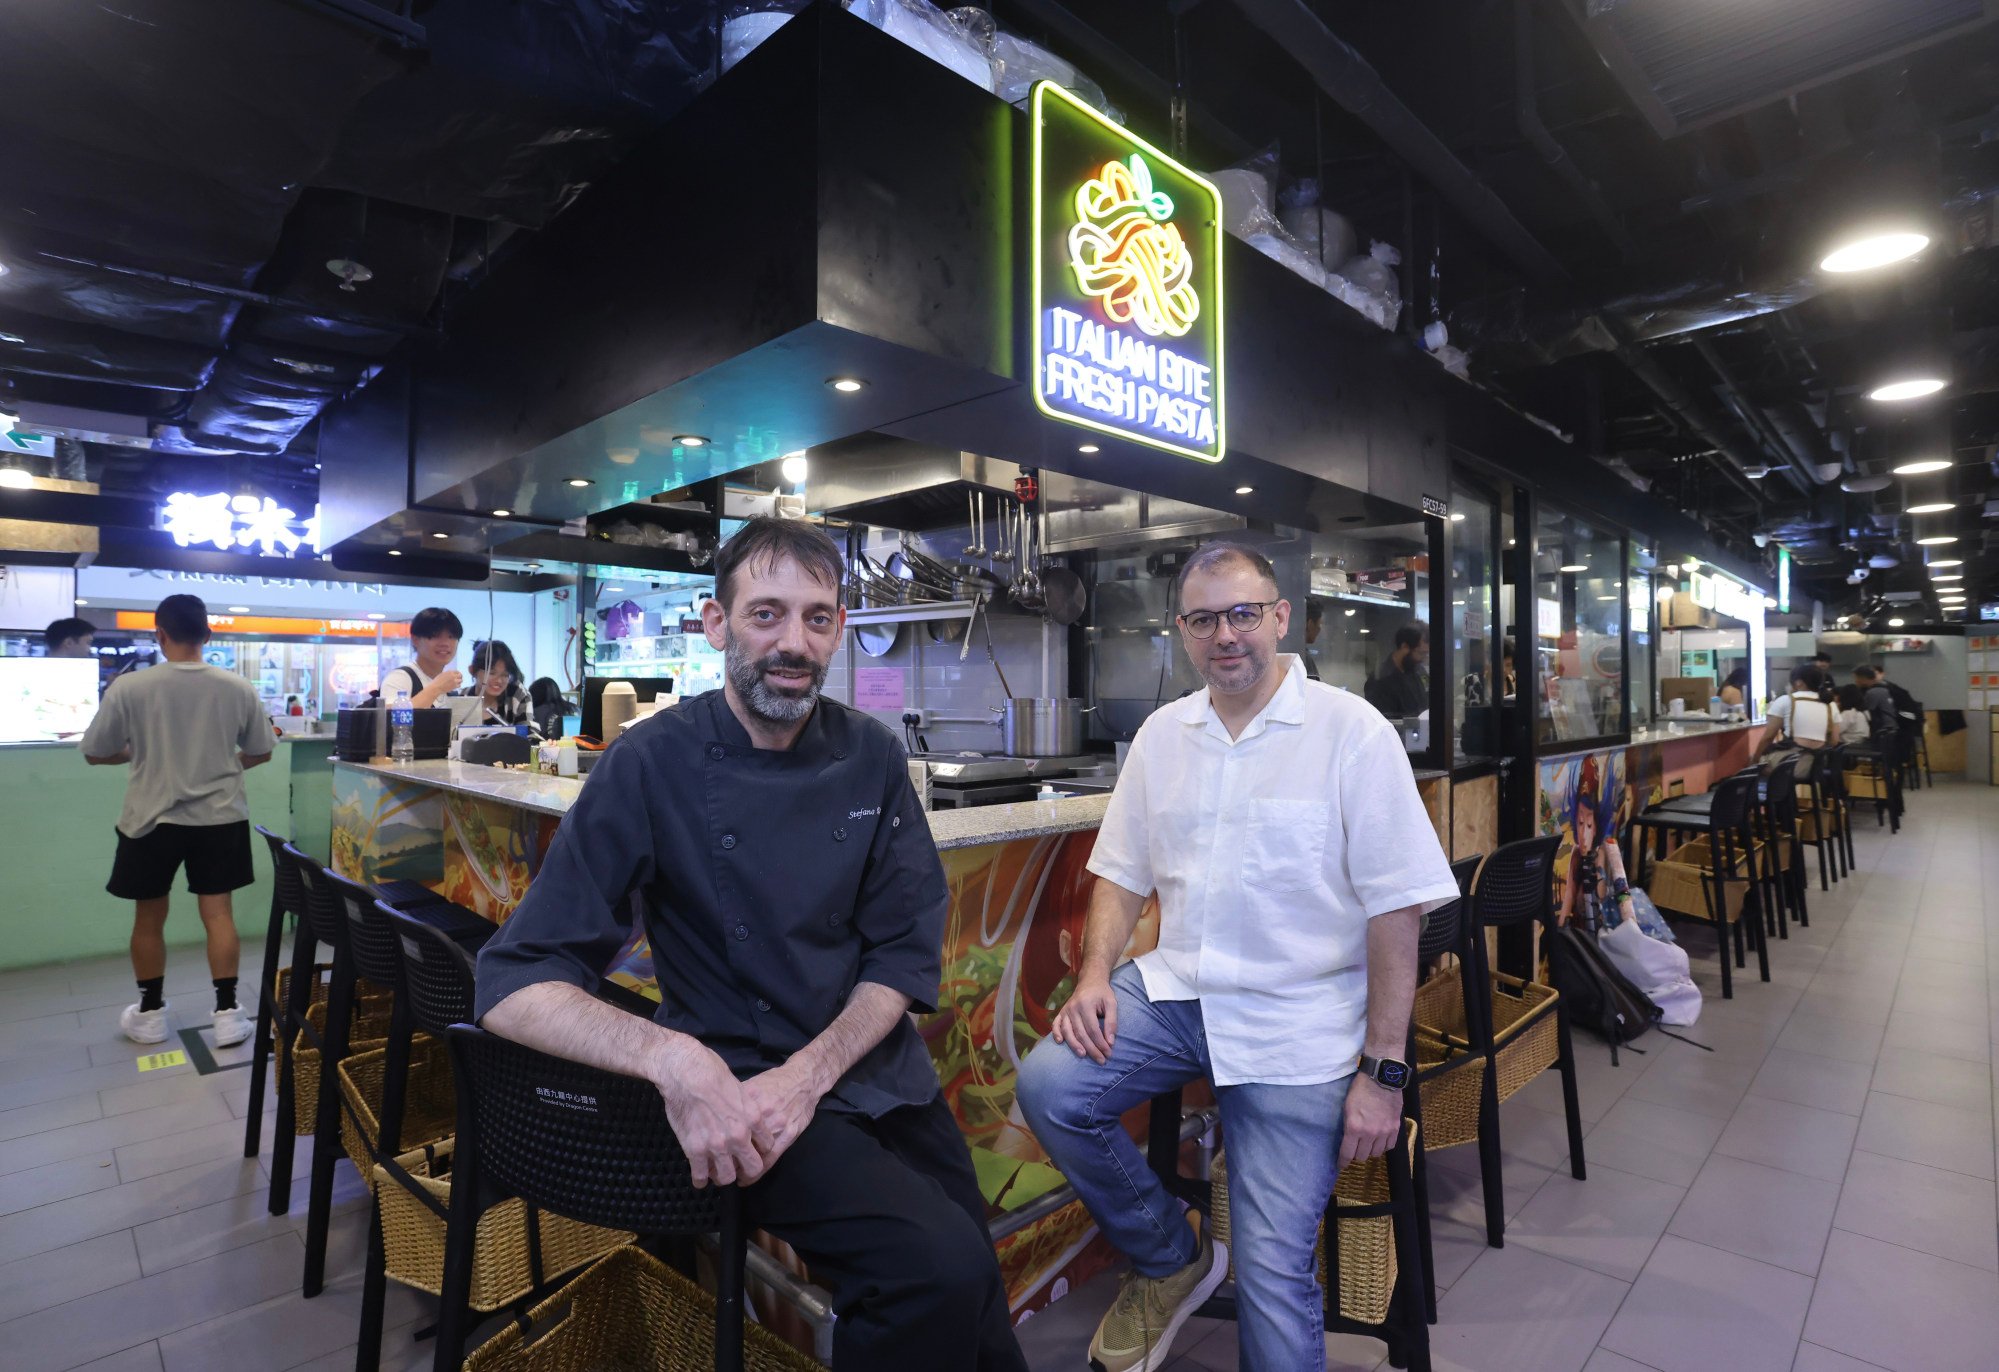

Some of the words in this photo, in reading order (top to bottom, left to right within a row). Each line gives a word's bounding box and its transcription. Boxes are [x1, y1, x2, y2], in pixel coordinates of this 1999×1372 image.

[1053, 307, 1156, 382] ITALIAN
[1158, 348, 1212, 403] BITE
[1046, 353, 1136, 420] FRESH
[1137, 385, 1216, 444] PASTA
[847, 807, 875, 820] Stefano
[540, 1097, 558, 1106] Provided
